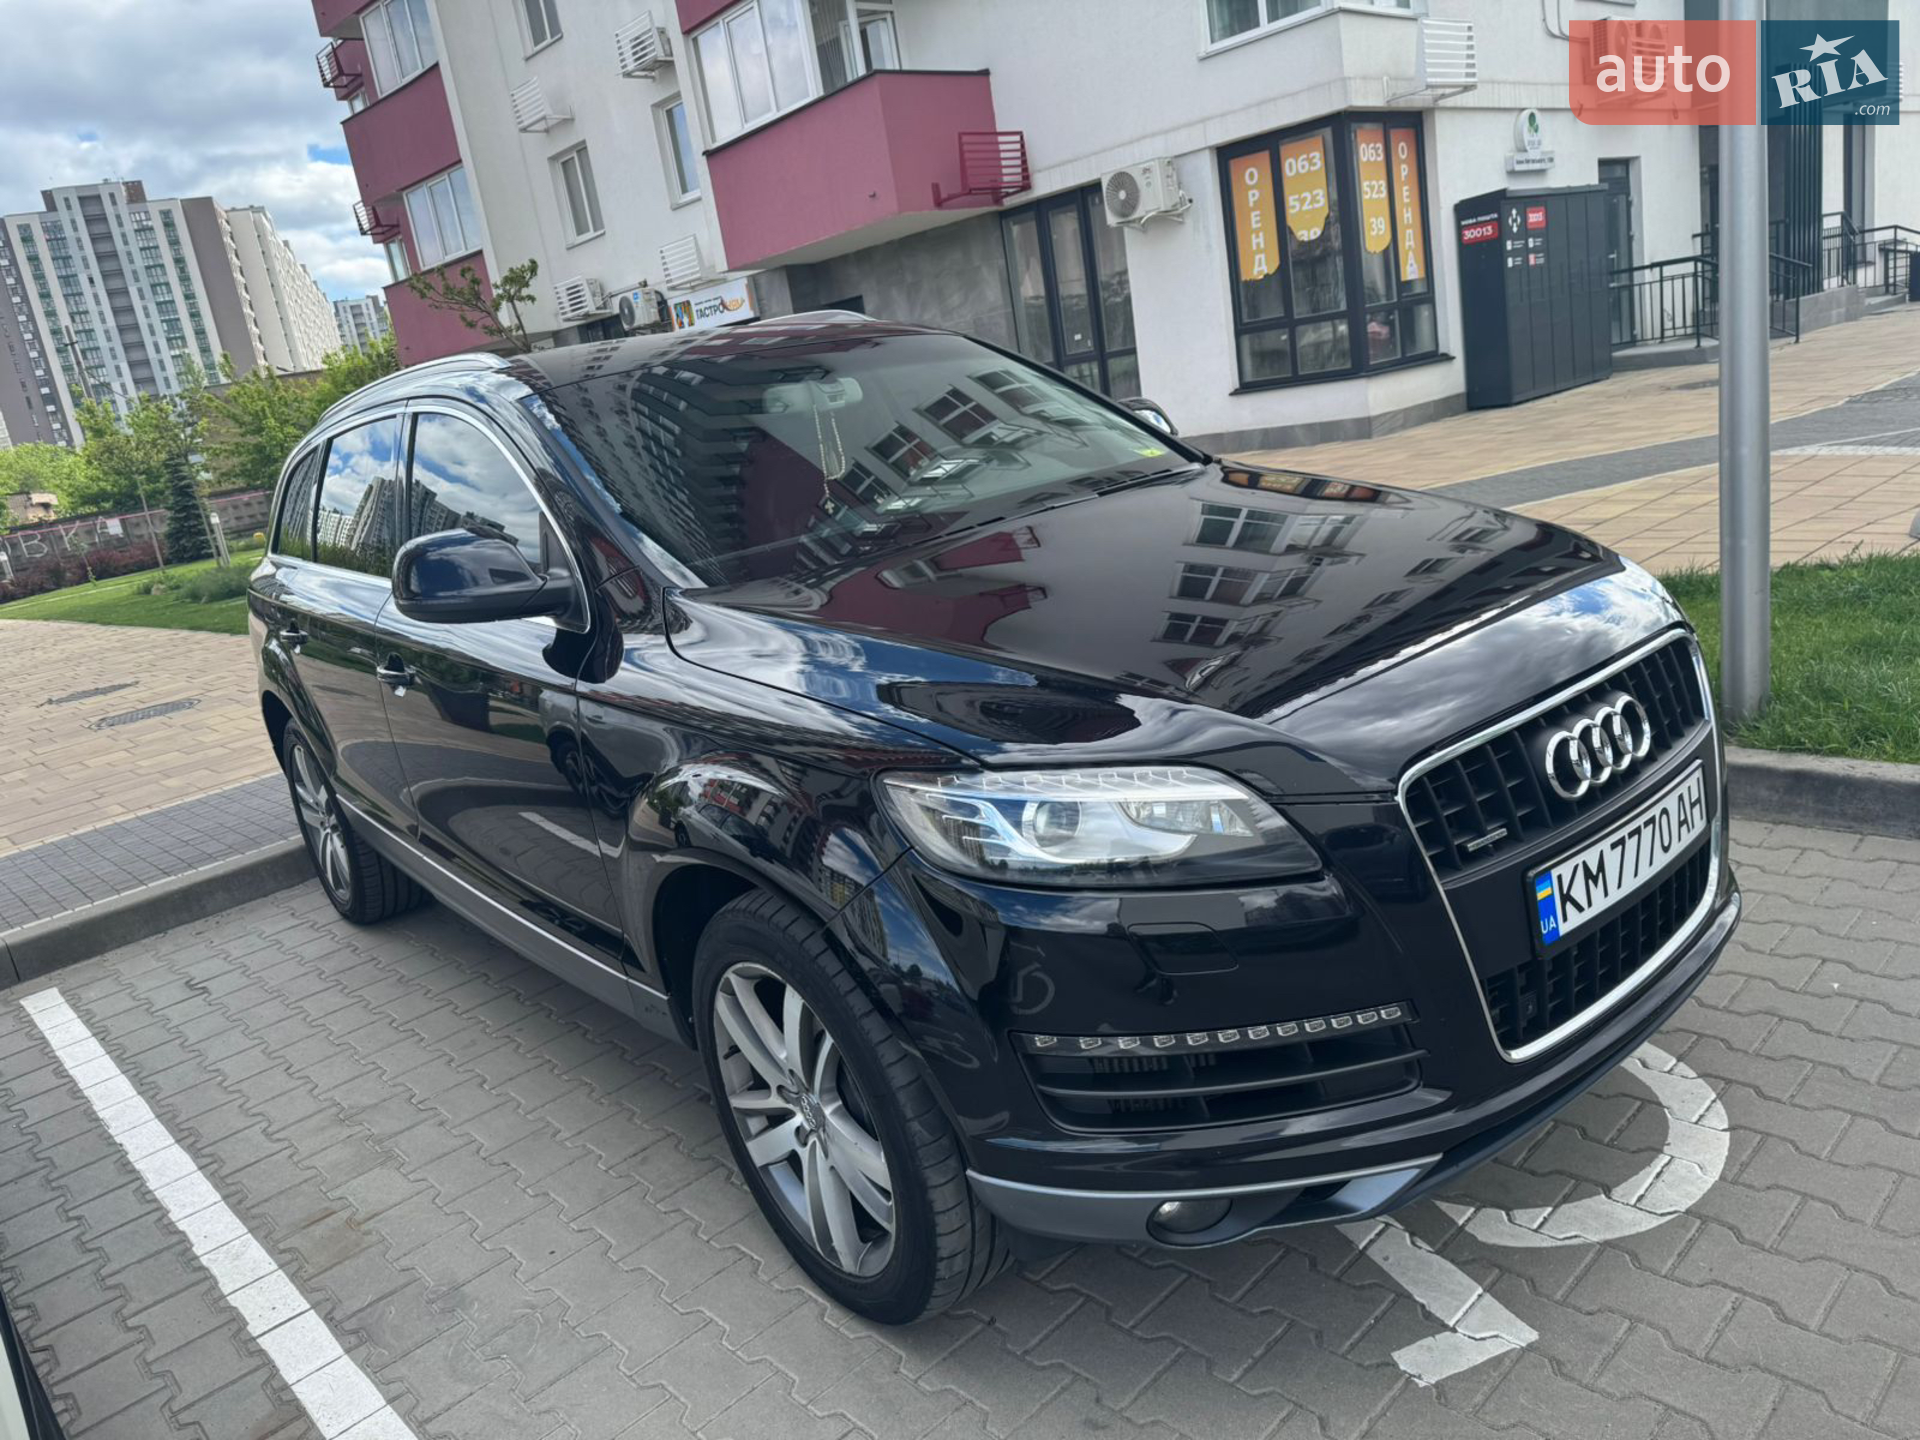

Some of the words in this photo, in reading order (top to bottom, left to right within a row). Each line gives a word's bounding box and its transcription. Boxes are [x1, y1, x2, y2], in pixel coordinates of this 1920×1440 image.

[1360, 143, 1383, 162] 063
[1284, 151, 1322, 177] 063
[1363, 180, 1386, 199] 523
[1288, 189, 1326, 213] 523
[1370, 217, 1385, 235] 39
[1540, 918, 1557, 934] UA
